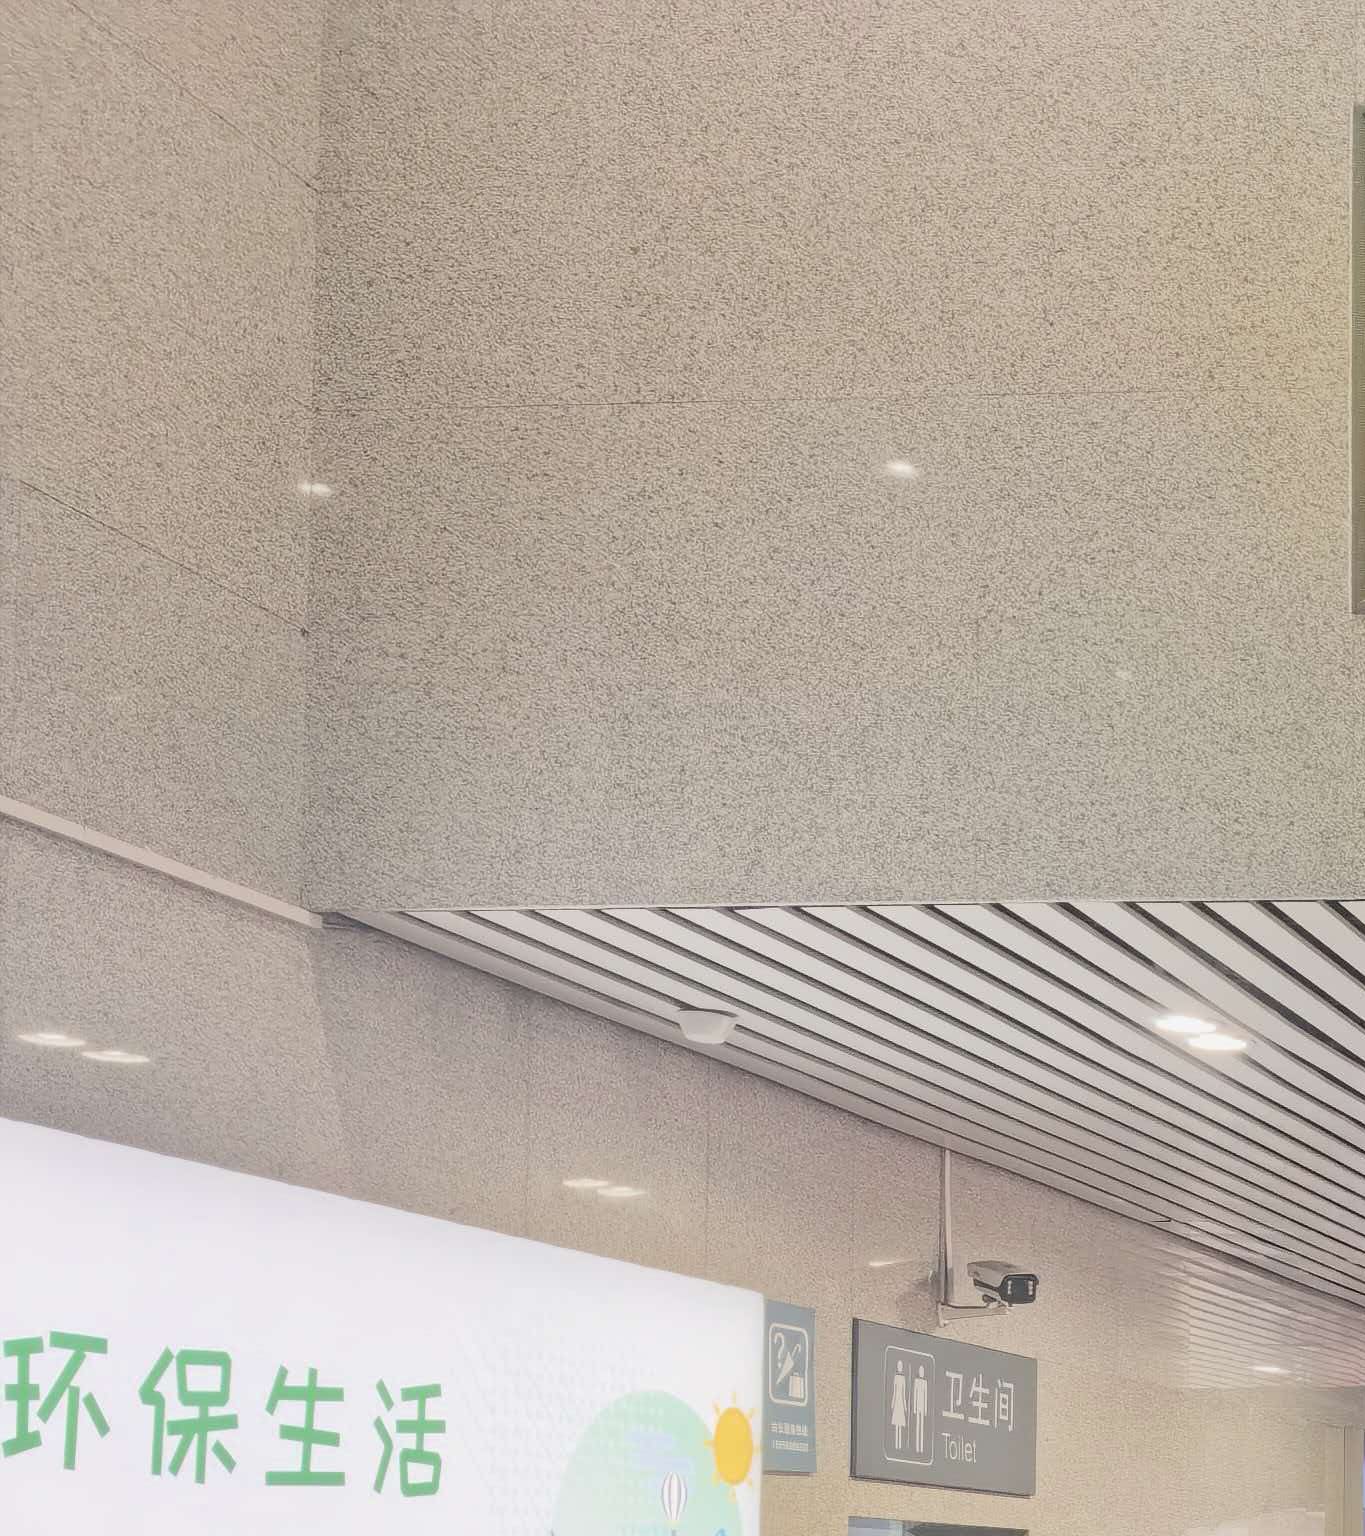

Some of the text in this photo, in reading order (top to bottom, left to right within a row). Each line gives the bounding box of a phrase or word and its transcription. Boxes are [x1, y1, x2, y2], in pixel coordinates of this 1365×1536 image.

[2, 1330, 446, 1497] 环保生活
[942, 1370, 1014, 1432] 卫生间
[942, 1432, 977, 1463] Toilet
